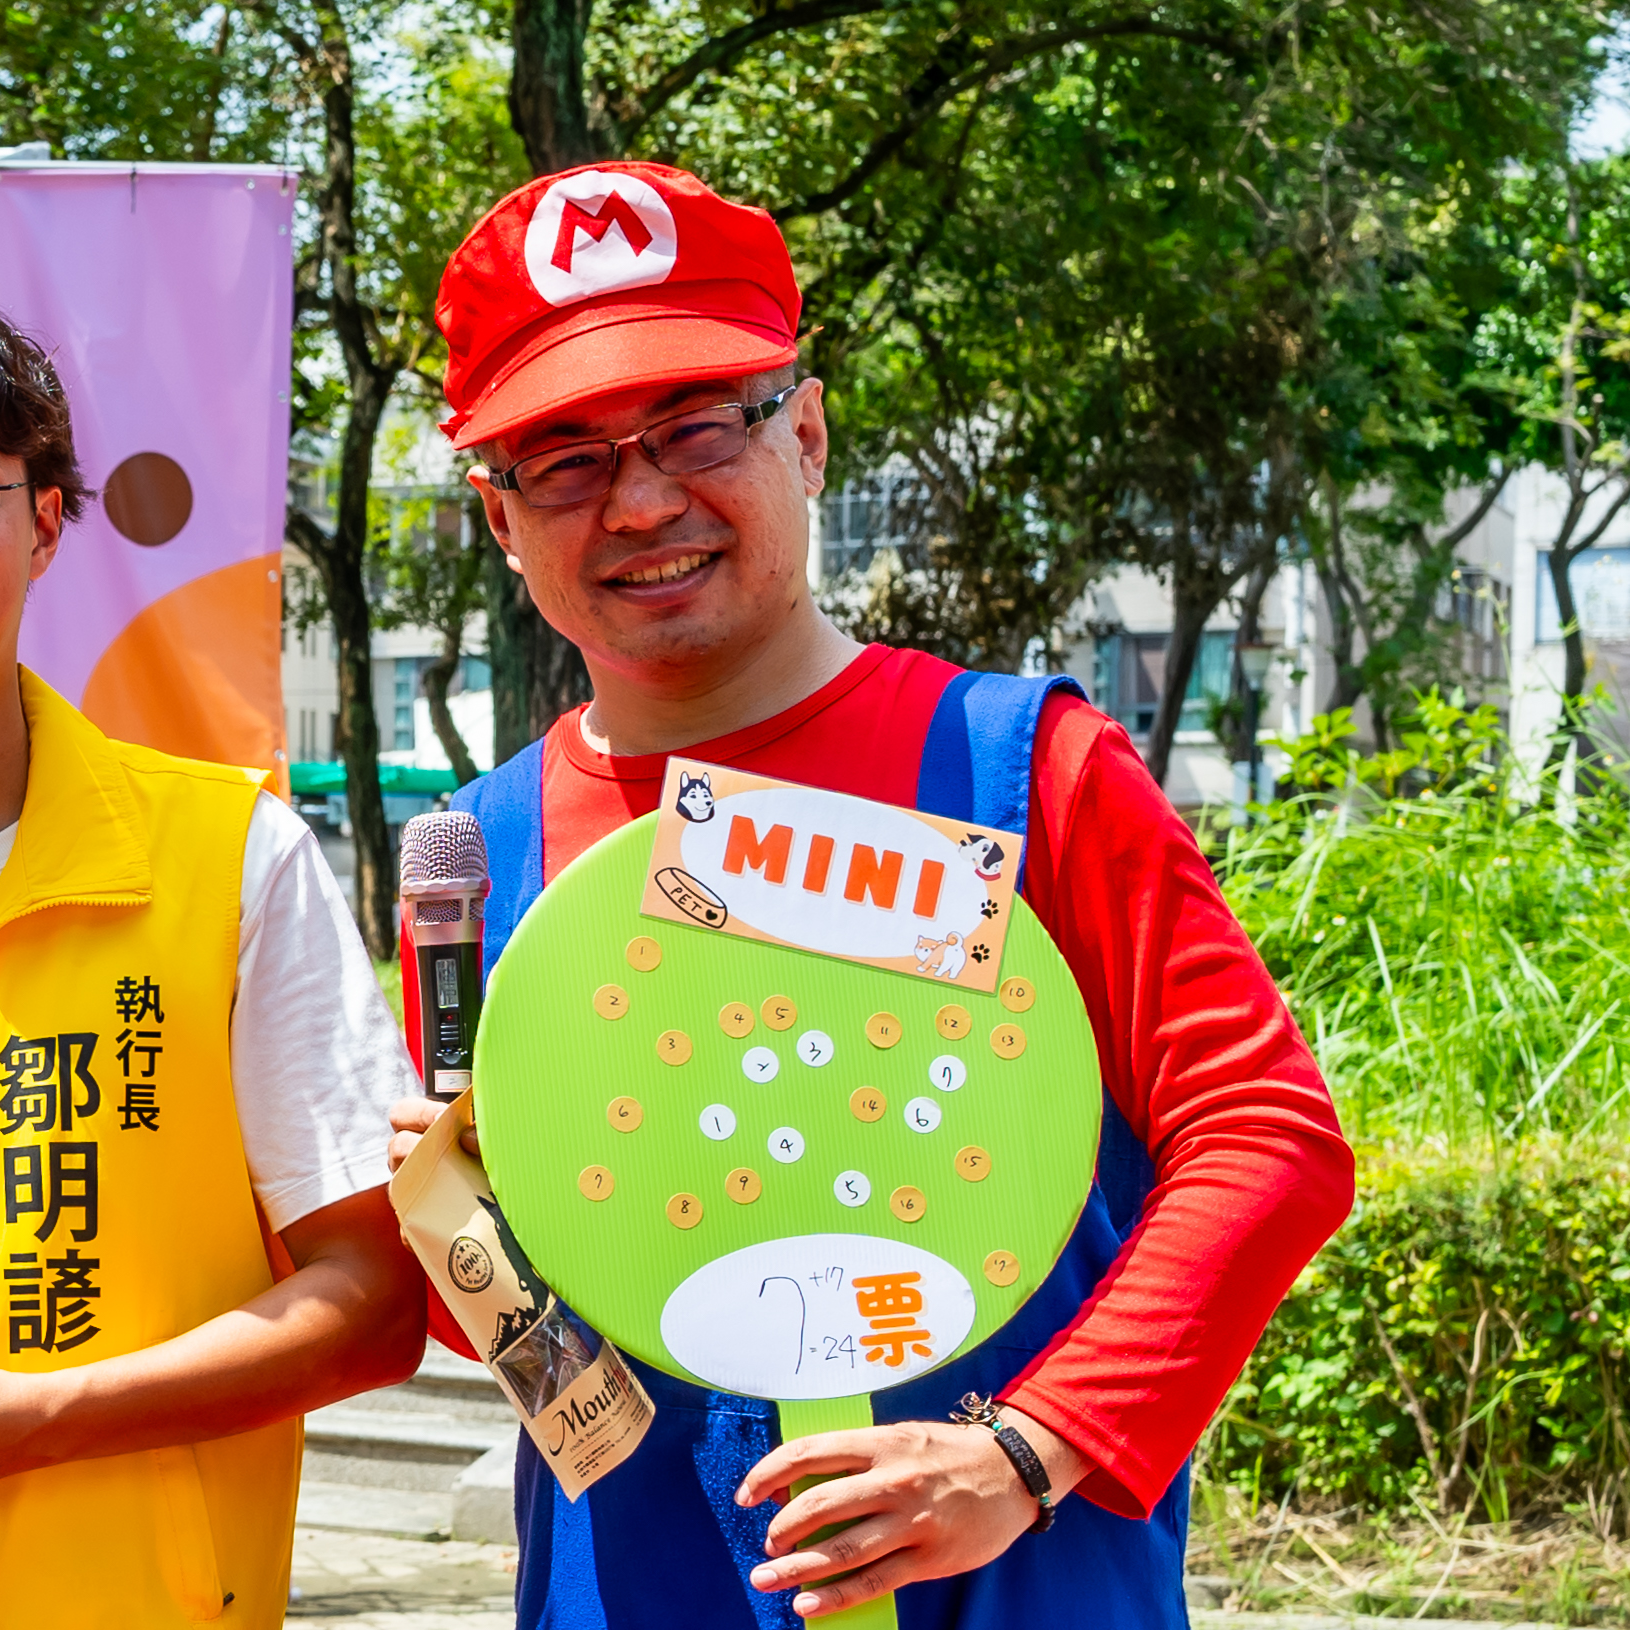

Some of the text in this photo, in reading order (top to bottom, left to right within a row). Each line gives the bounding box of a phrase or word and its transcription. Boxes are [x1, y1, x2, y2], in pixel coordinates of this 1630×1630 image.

[550, 188, 655, 274] M
[722, 814, 946, 920] MINI
[670, 886, 702, 912] PET
[608, 995, 620, 1006] 2
[733, 1012, 745, 1024] 4
[774, 1006, 790, 1021] 5
[668, 1037, 676, 1050] 3
[114, 974, 165, 1132] 執行長
[617, 1104, 629, 1118] 6
[739, 1175, 749, 1191] 9
[680, 1199, 691, 1214] 8
[852, 1270, 935, 1369] 票
